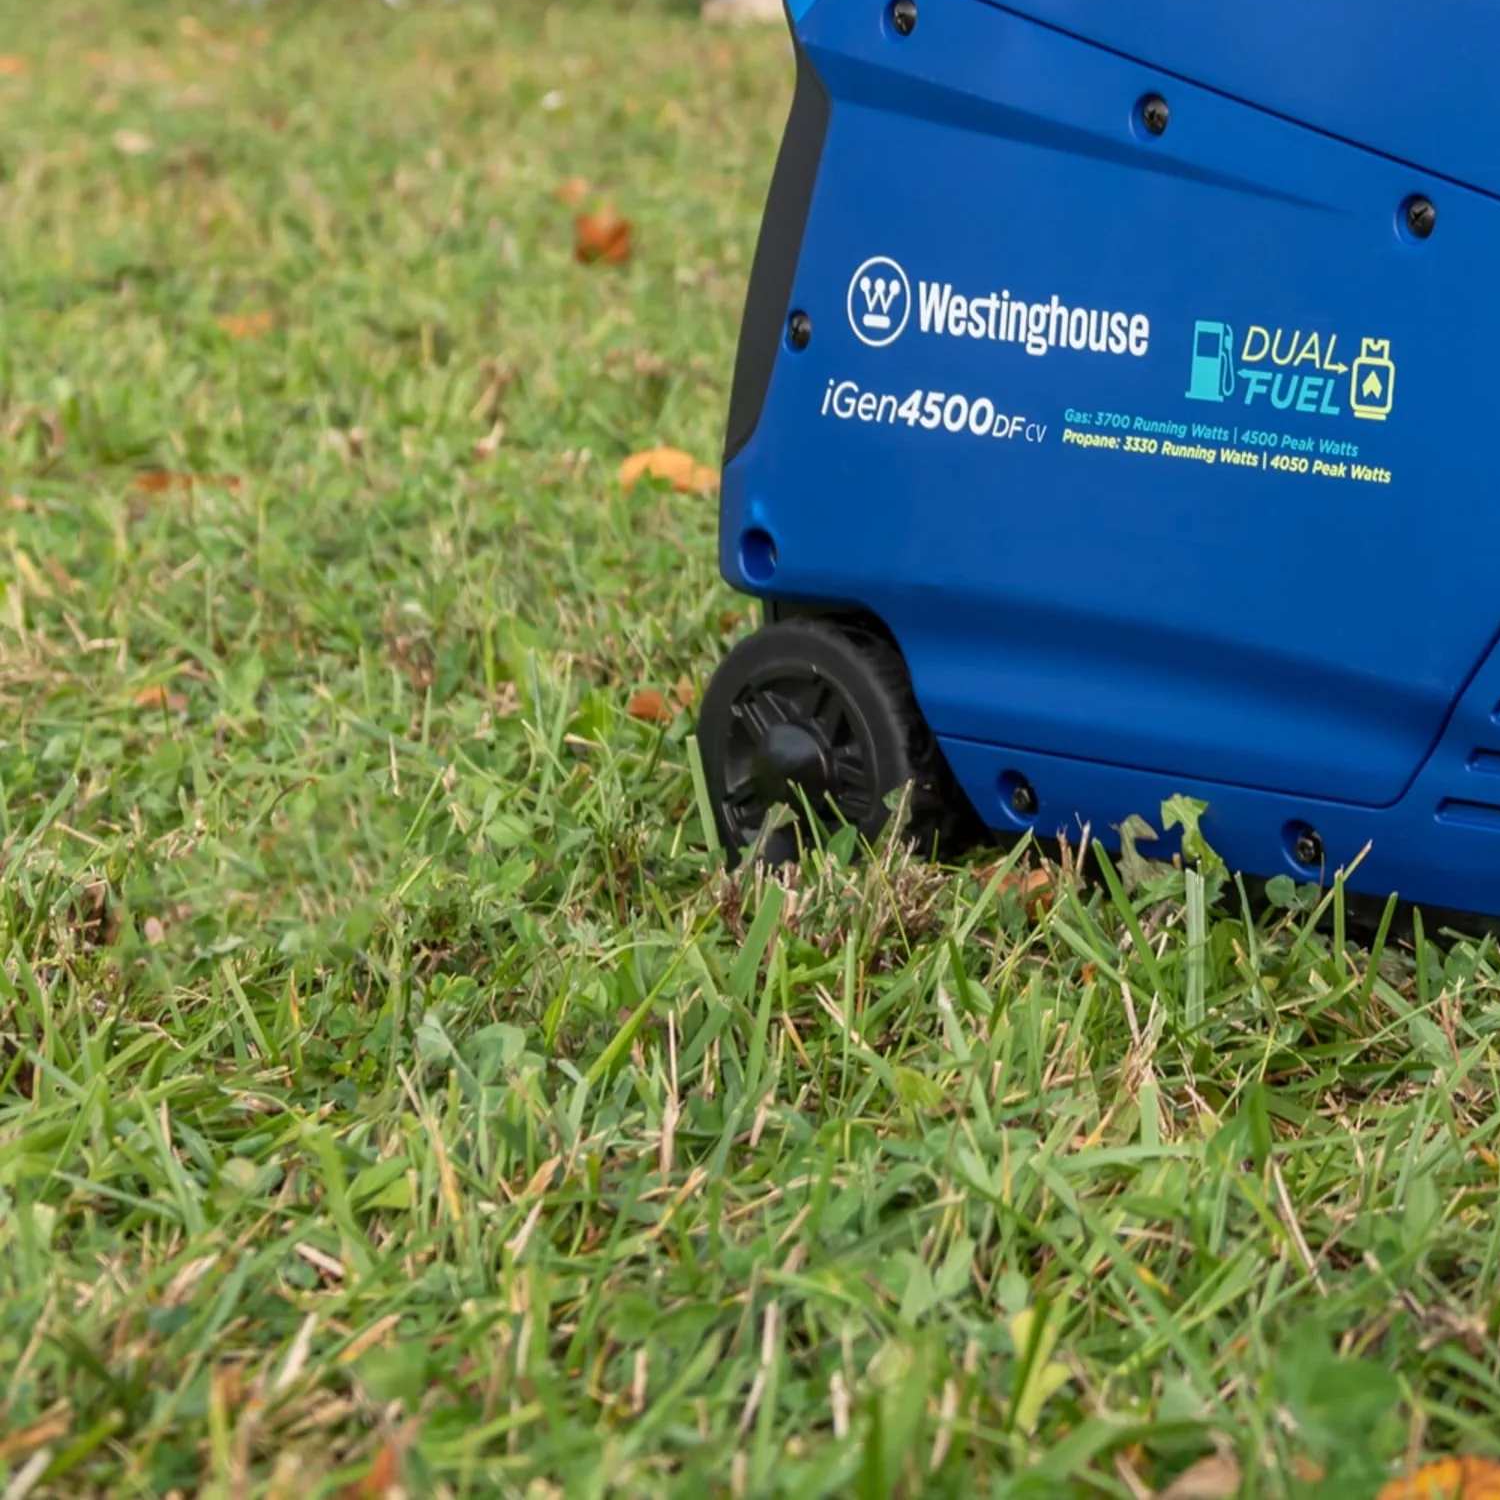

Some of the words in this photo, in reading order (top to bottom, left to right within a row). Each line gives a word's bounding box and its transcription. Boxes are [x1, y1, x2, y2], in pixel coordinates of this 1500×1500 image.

[918, 281, 1150, 357] Westinghouse
[1241, 325, 1340, 370] DUAL
[1243, 368, 1341, 416] FUEL
[1062, 428, 1121, 449] Propane:
[1122, 435, 1158, 454] 3330
[1161, 440, 1217, 464] Running
[1220, 447, 1259, 467] Watts
[1269, 454, 1309, 473] 4050
[1311, 459, 1348, 478] Peak
[1350, 464, 1392, 484] Watts
[1064, 408, 1093, 425] Gas:
[1095, 411, 1131, 429] 3700
[1132, 416, 1187, 439] Running
[1191, 423, 1230, 442] Watts
[1241, 429, 1278, 448] 4500
[1280, 434, 1315, 452] Peak
[1319, 438, 1359, 458] Watts
